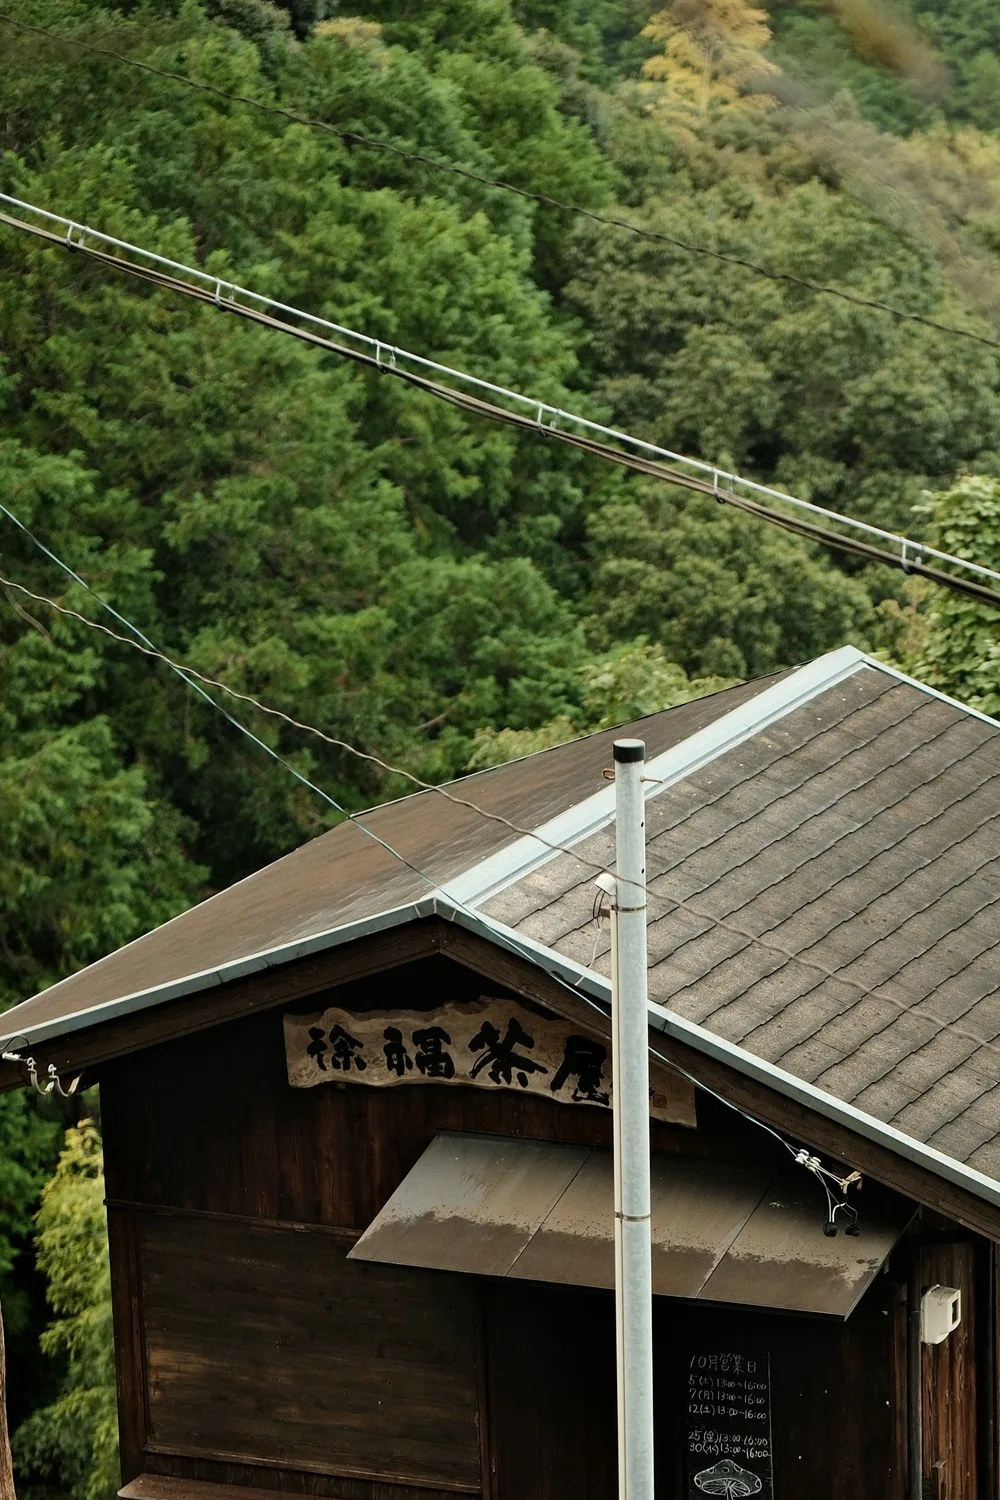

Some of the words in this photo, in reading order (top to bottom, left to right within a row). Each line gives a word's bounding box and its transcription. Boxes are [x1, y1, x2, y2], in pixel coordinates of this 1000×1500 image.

[306, 1016, 613, 1105] 徐福茶屋
[690, 1353, 757, 1375] 10月営業日
